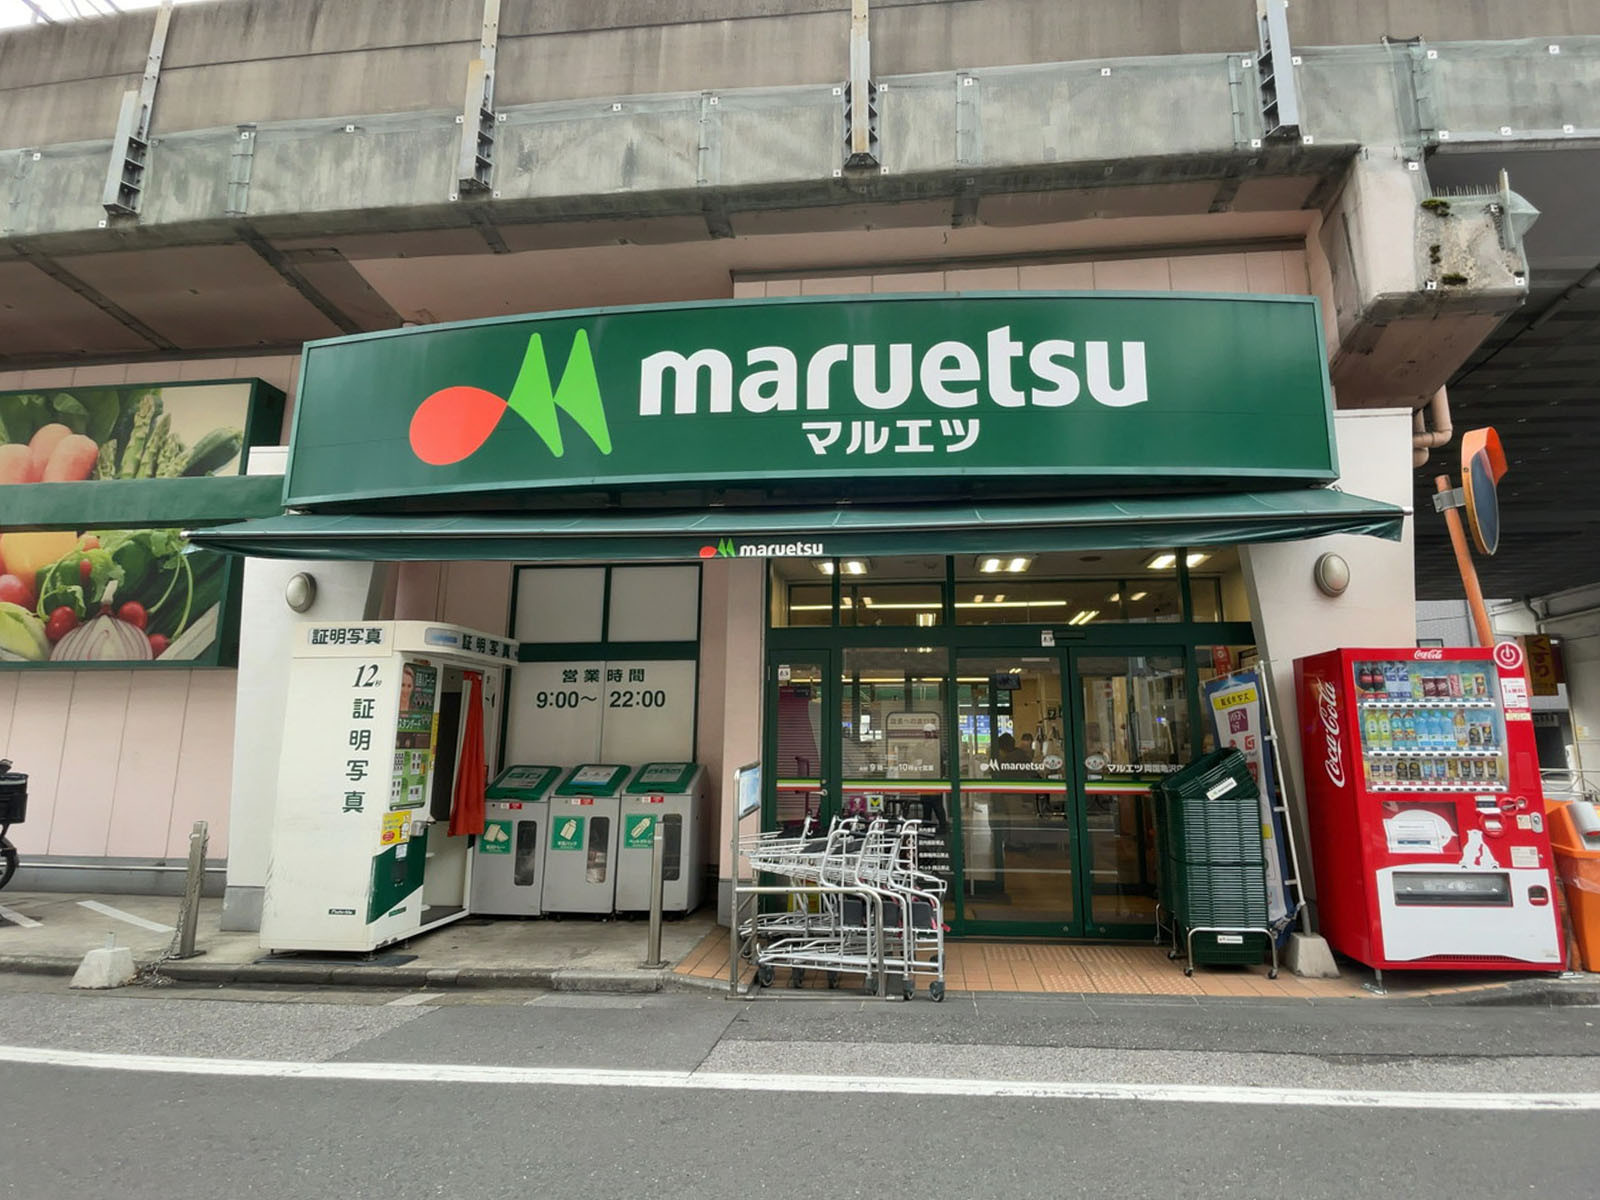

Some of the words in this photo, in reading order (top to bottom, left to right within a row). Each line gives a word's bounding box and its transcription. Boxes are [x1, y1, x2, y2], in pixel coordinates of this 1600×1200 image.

[639, 325, 1148, 416] maruetsu
[802, 418, 980, 454] マルエツ
[740, 541, 824, 557] maruetsu
[312, 628, 383, 645] 証明写真
[562, 668, 645, 683] 営業時間
[609, 690, 666, 708] 22:00
[1319, 679, 1345, 788] Coca-Cola
[342, 698, 376, 814] 証明写真
[1001, 761, 1044, 771] maruetsu
